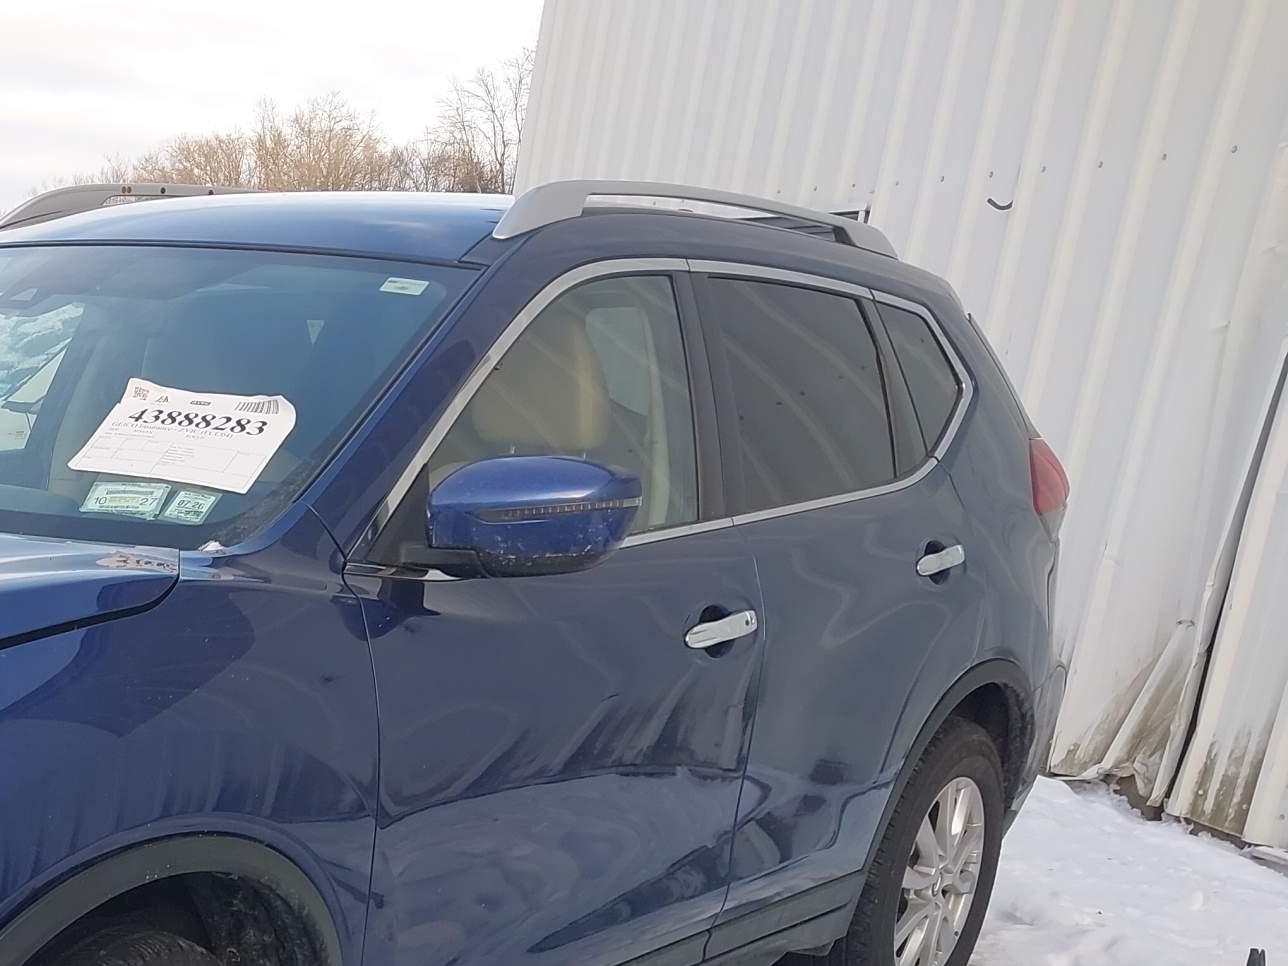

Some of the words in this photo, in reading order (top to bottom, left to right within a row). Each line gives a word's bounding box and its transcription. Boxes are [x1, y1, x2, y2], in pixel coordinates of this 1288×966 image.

[128, 407, 268, 436] 43888283
[94, 496, 107, 505] 10
[139, 497, 157, 506] 27
